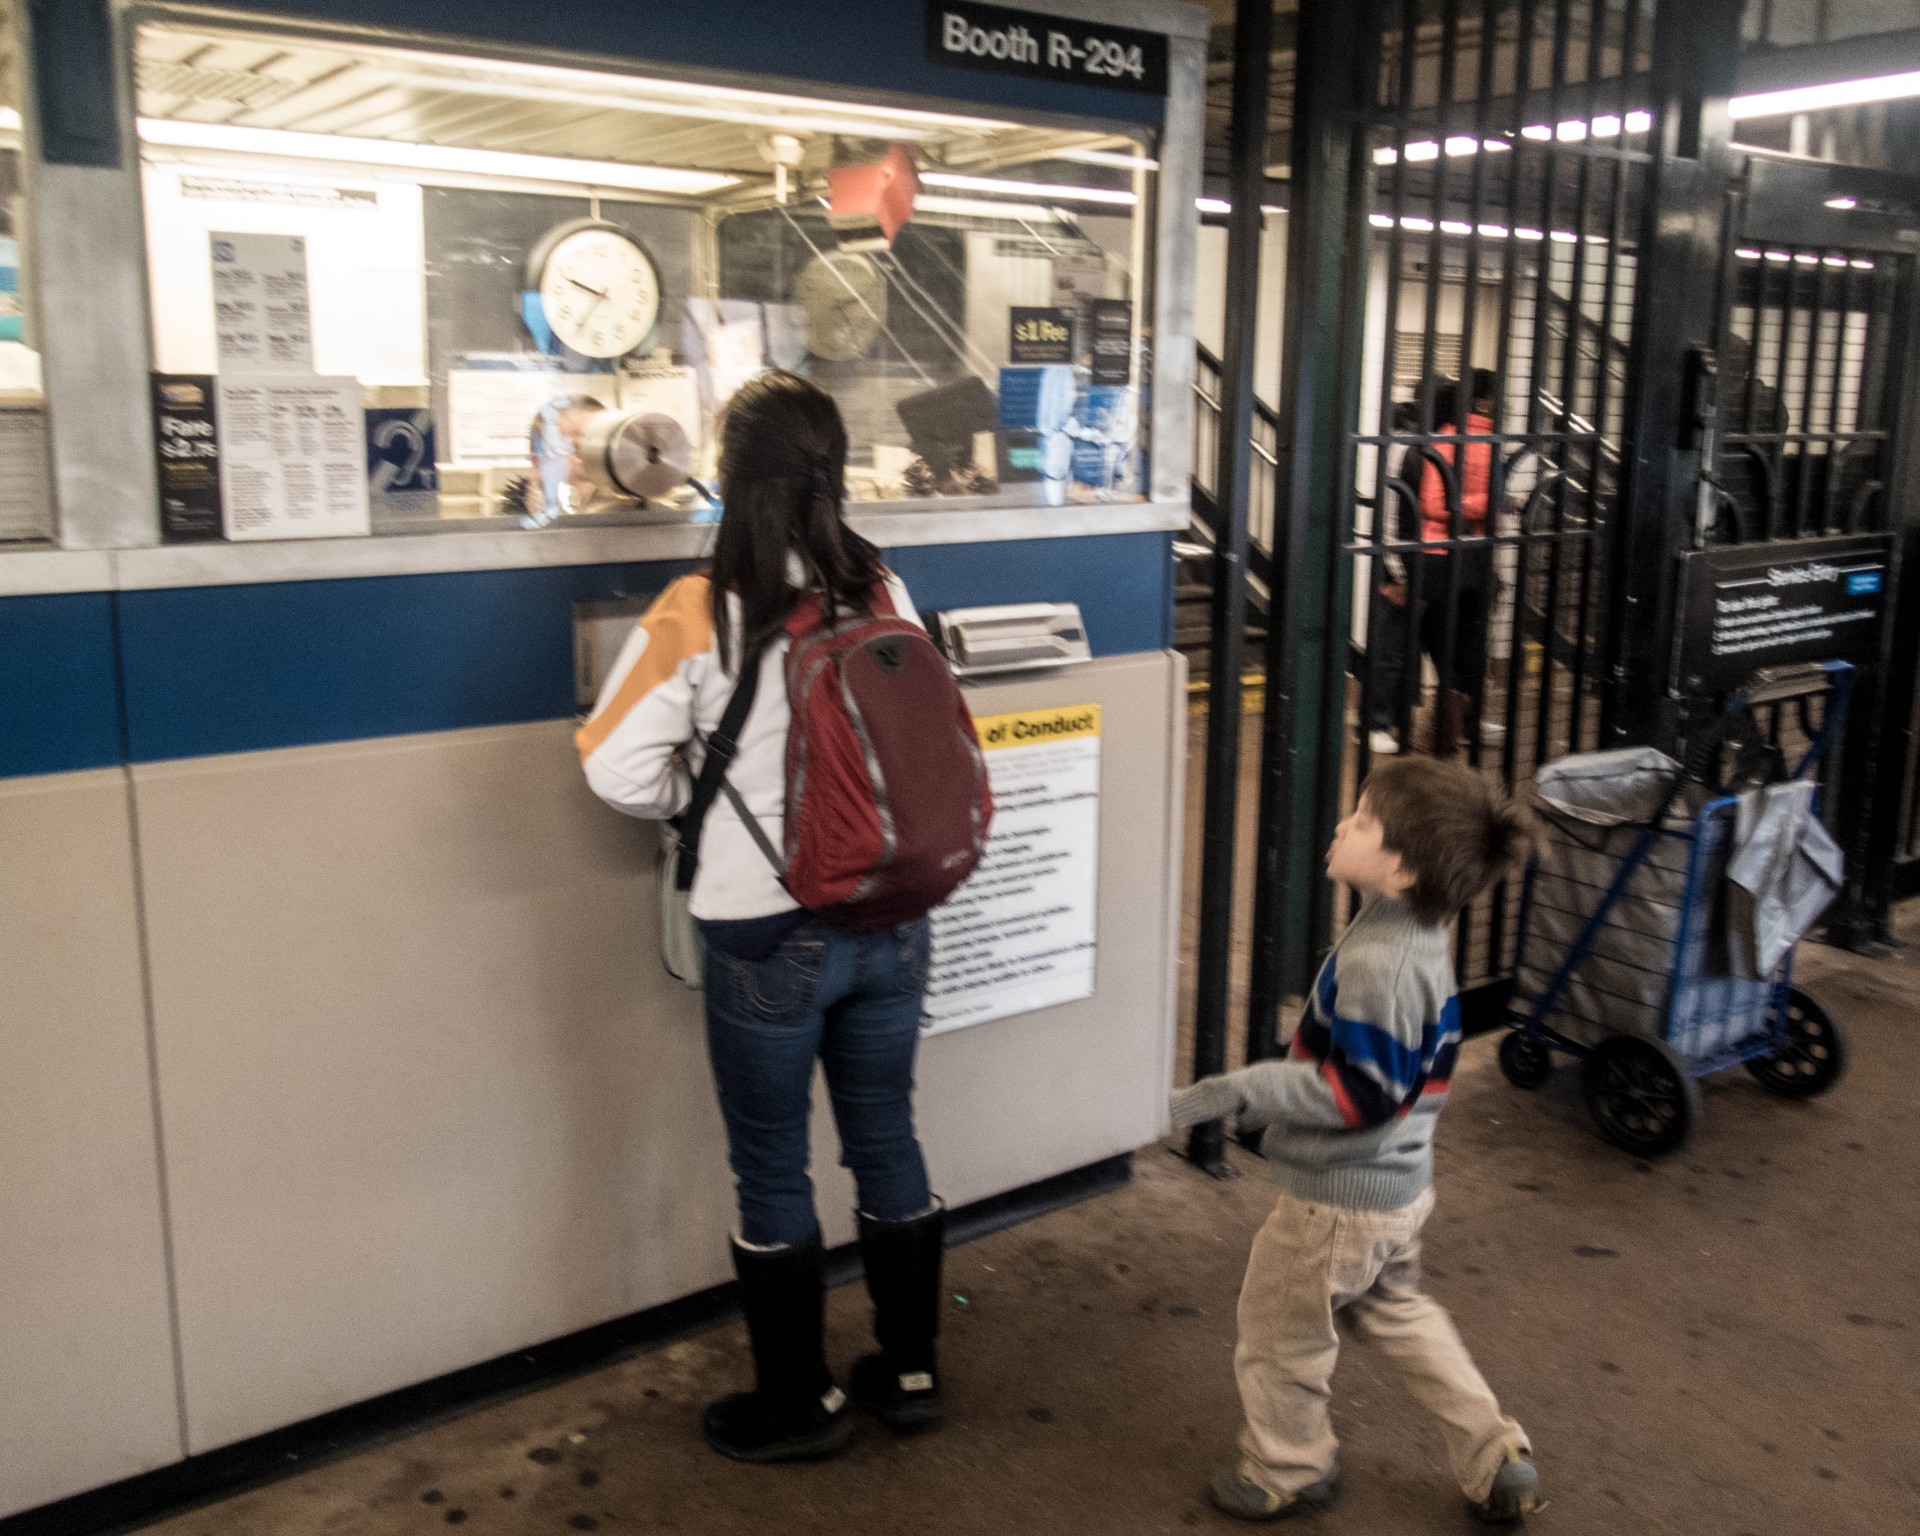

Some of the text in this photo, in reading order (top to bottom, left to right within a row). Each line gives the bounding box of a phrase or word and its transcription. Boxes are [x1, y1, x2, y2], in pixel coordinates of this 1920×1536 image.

[942, 11, 1146, 80] Booth R-294
[986, 712, 1095, 743] of Conduct
